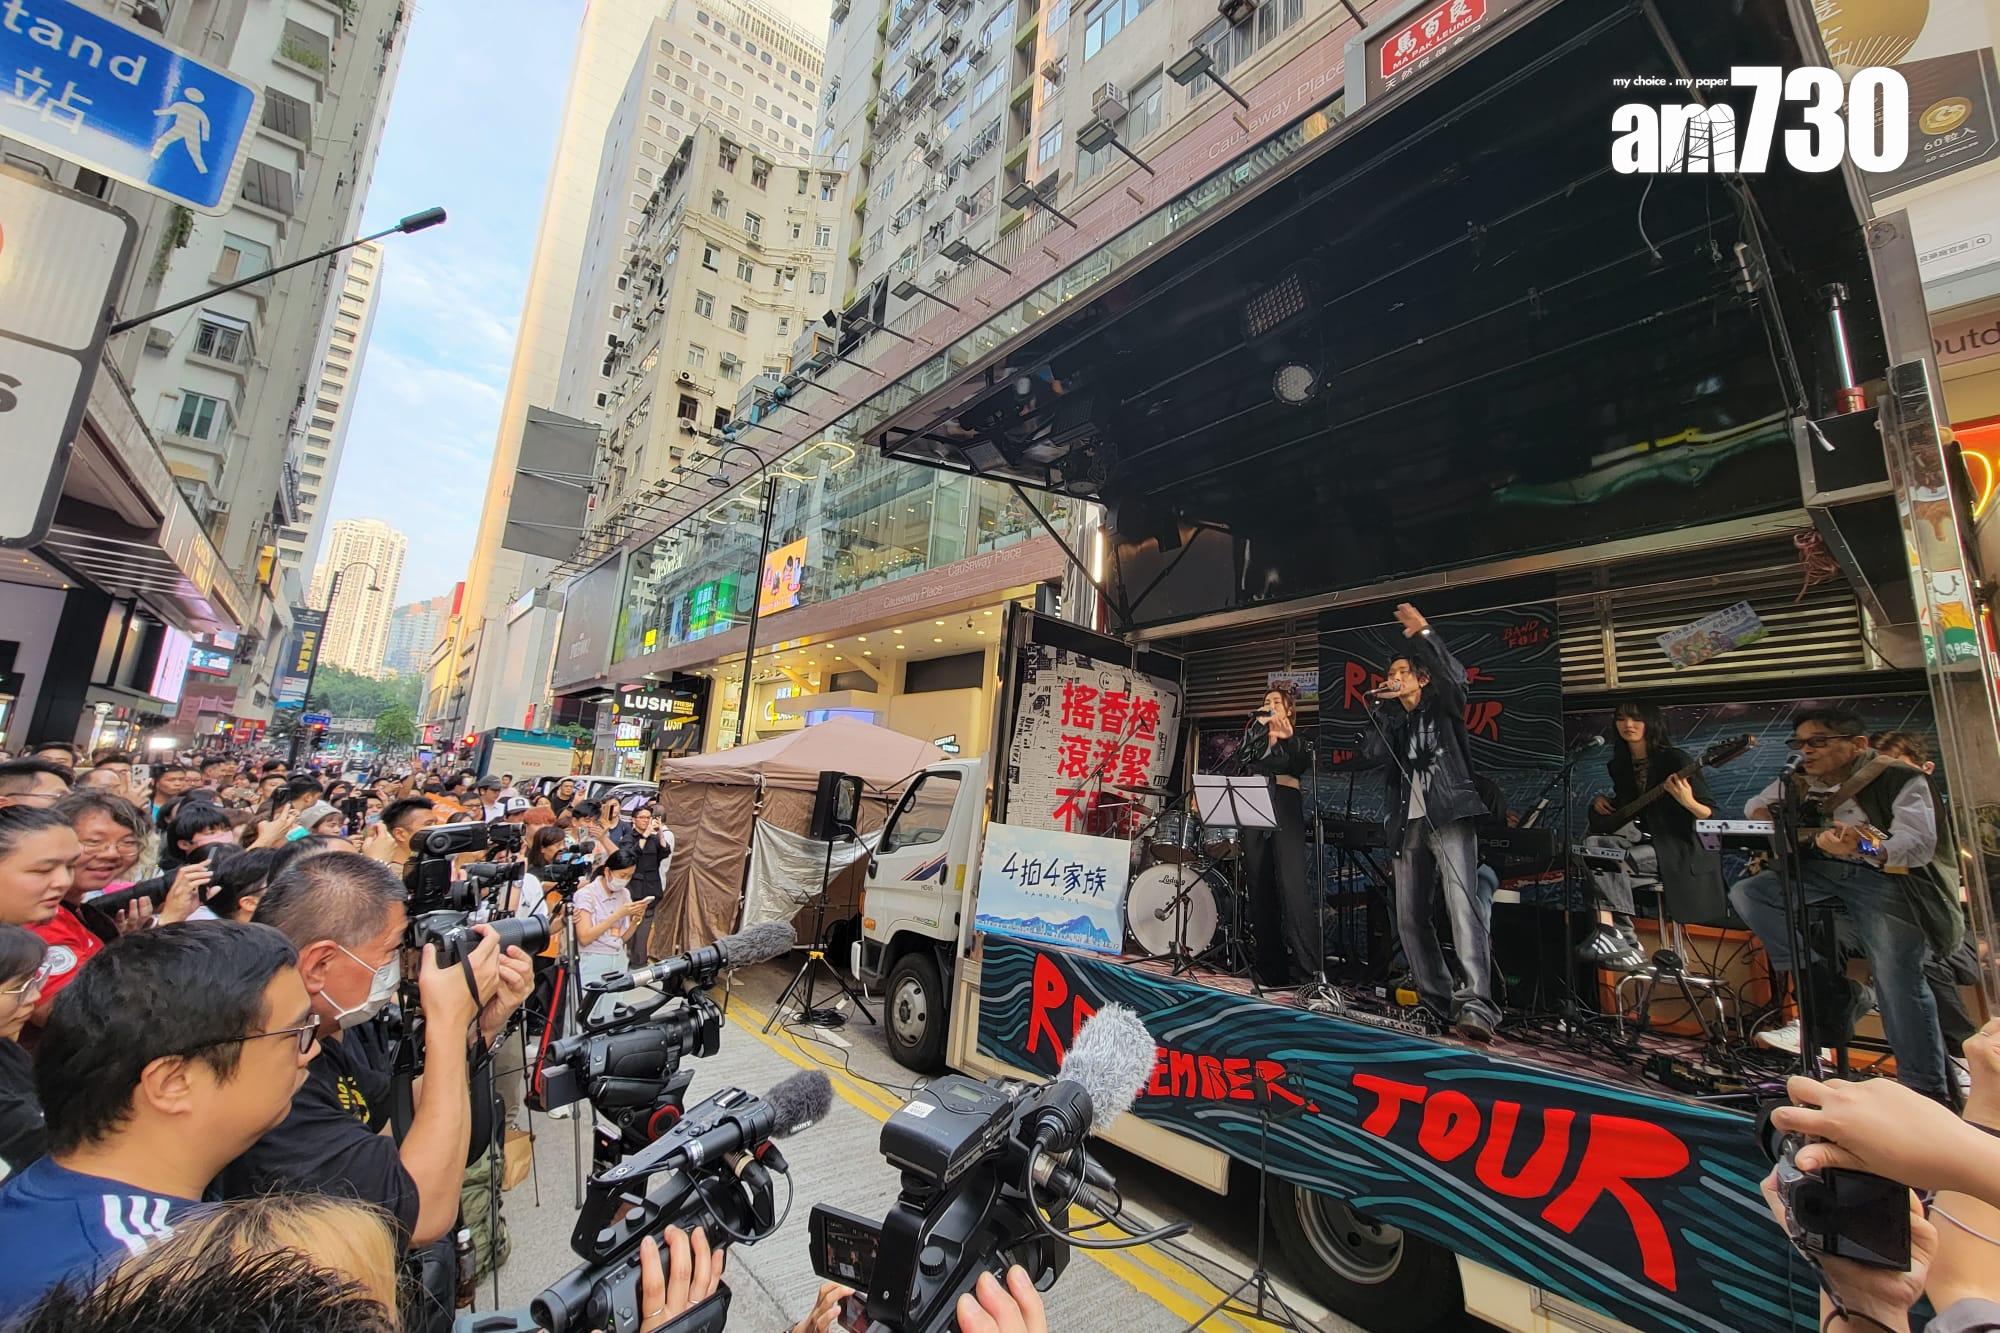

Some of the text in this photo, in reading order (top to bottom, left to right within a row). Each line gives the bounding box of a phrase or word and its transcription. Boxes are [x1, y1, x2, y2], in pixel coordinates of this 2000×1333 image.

[1392, 15, 1473, 70] MA PAK LEUNG
[5, 66, 94, 136] 站
[1297, 60, 1345, 103] Place
[947, 547, 1022, 578] Causeway Place
[883, 590, 919, 610] Causeway
[920, 584, 944, 600] Place
[1503, 619, 1540, 641] BAND
[624, 694, 673, 713] LUSH
[1001, 852, 1107, 898] 4拍4家族
[1351, 1073, 1691, 1294] TOUR
